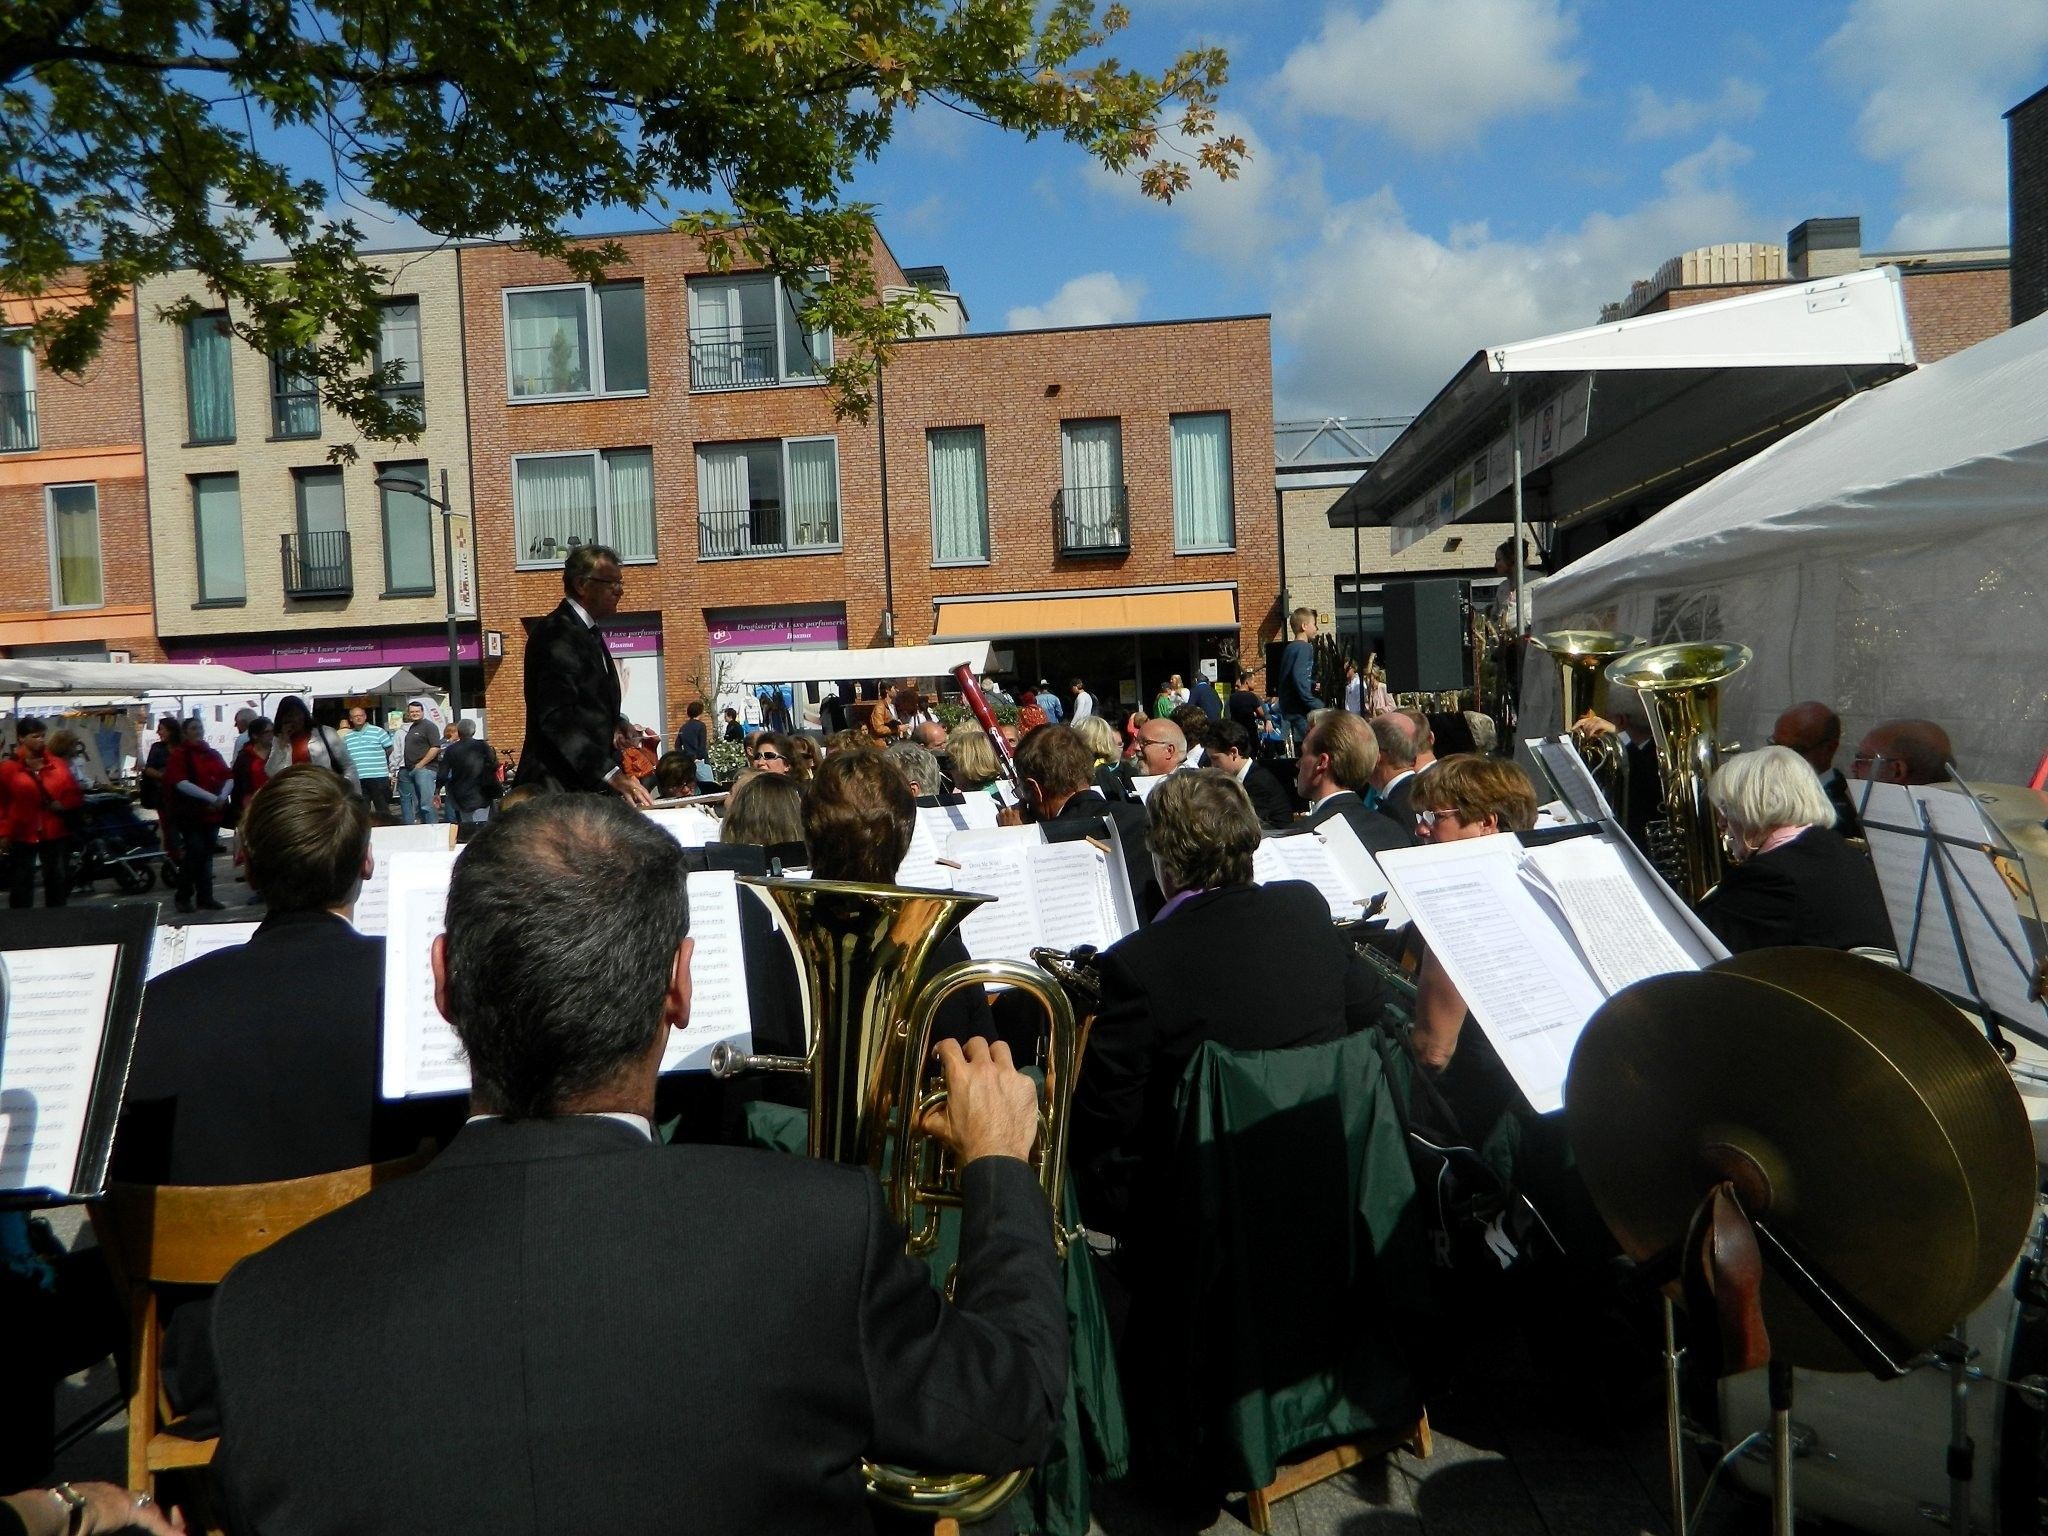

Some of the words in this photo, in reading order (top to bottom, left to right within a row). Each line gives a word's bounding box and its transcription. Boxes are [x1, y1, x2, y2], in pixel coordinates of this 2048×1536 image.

[737, 622, 777, 632] Drogisterij
[787, 621, 804, 629] Luxe
[806, 618, 846, 629] parfumerie
[787, 632, 812, 640] Bosma
